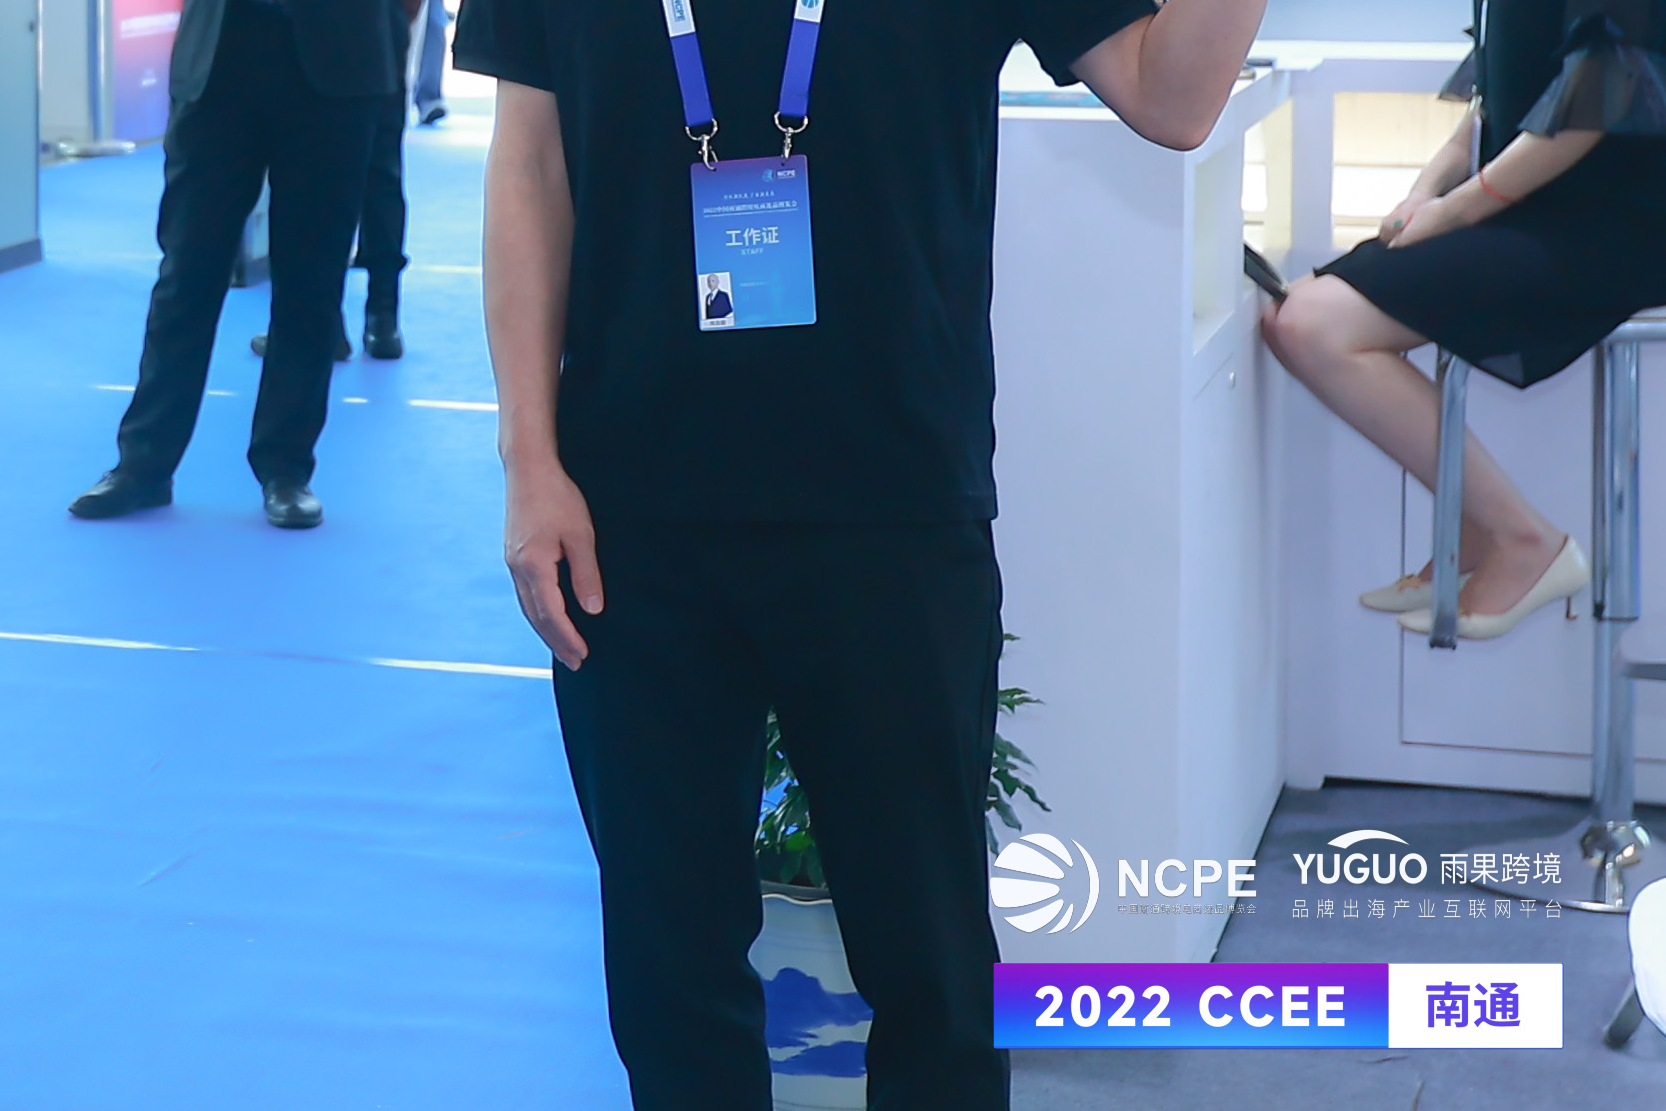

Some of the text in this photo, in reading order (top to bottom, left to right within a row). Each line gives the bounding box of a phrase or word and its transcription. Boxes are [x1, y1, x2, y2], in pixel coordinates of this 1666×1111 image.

[777, 169, 796, 178] NCPE
[725, 226, 780, 247] 工作证
[741, 247, 764, 256] STAFF
